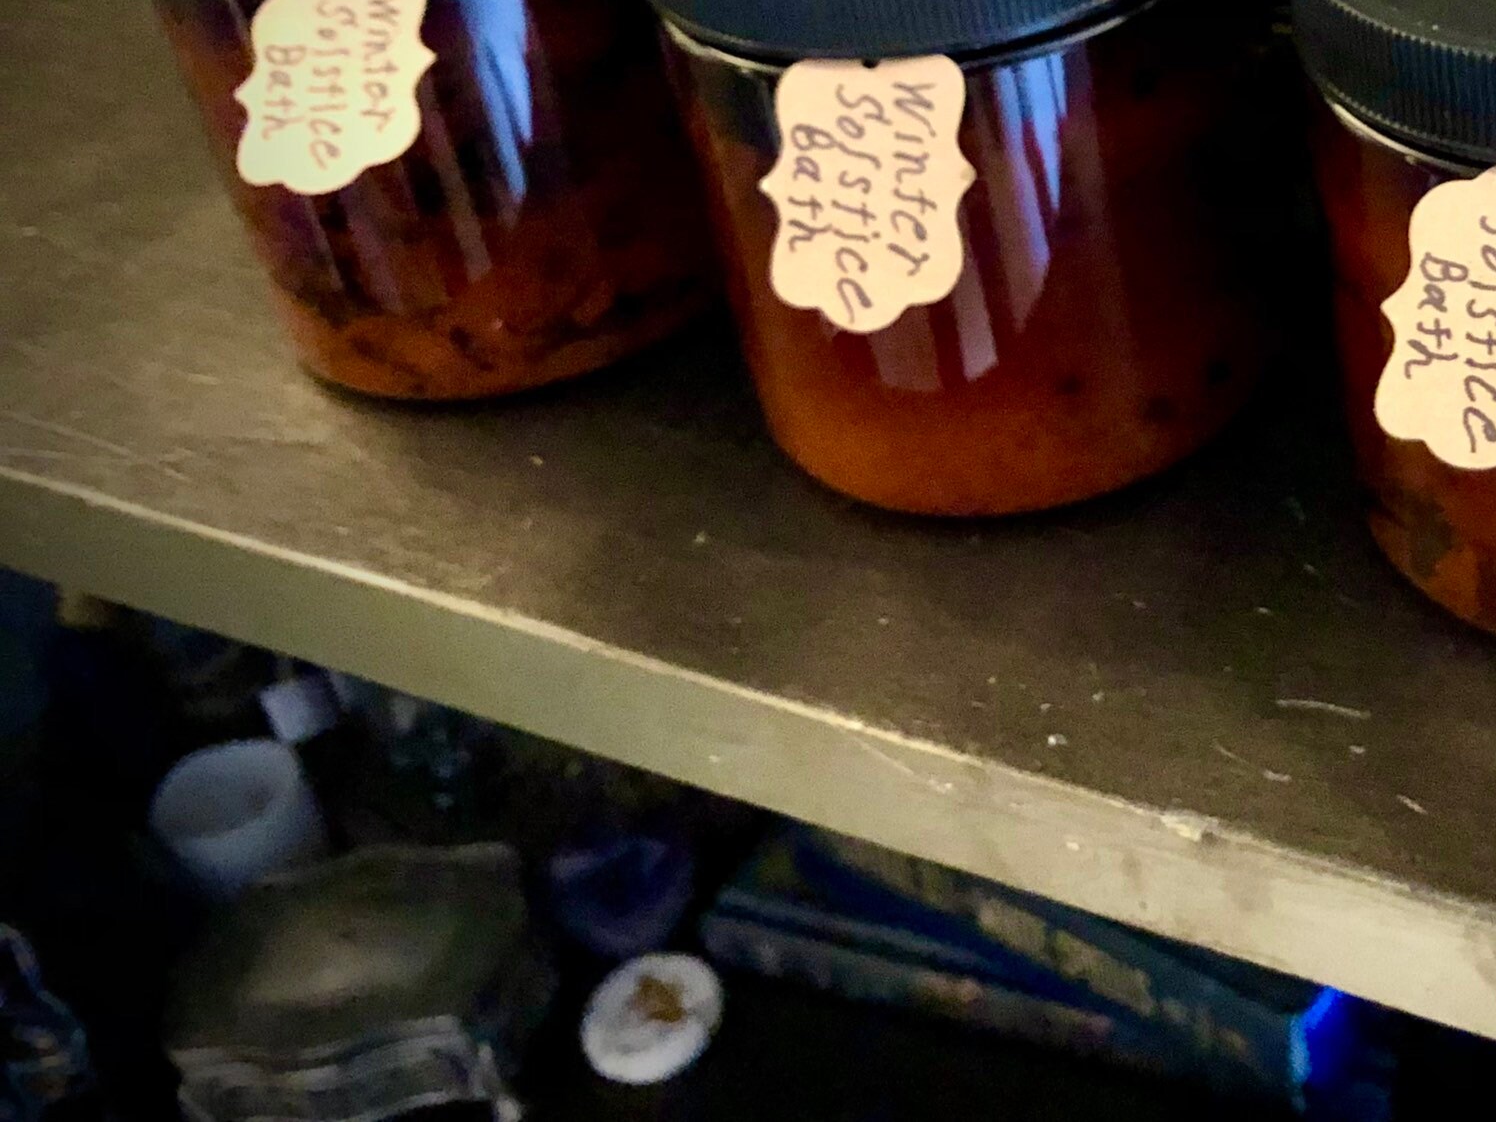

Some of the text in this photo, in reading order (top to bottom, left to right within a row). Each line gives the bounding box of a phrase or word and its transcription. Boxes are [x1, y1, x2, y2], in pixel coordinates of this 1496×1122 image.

[262, 44, 306, 140] Bath
[788, 124, 837, 253] Bath
[831, 84, 893, 324] Solstice
[887, 82, 938, 277] Winter
[1404, 252, 1469, 379] Bath
